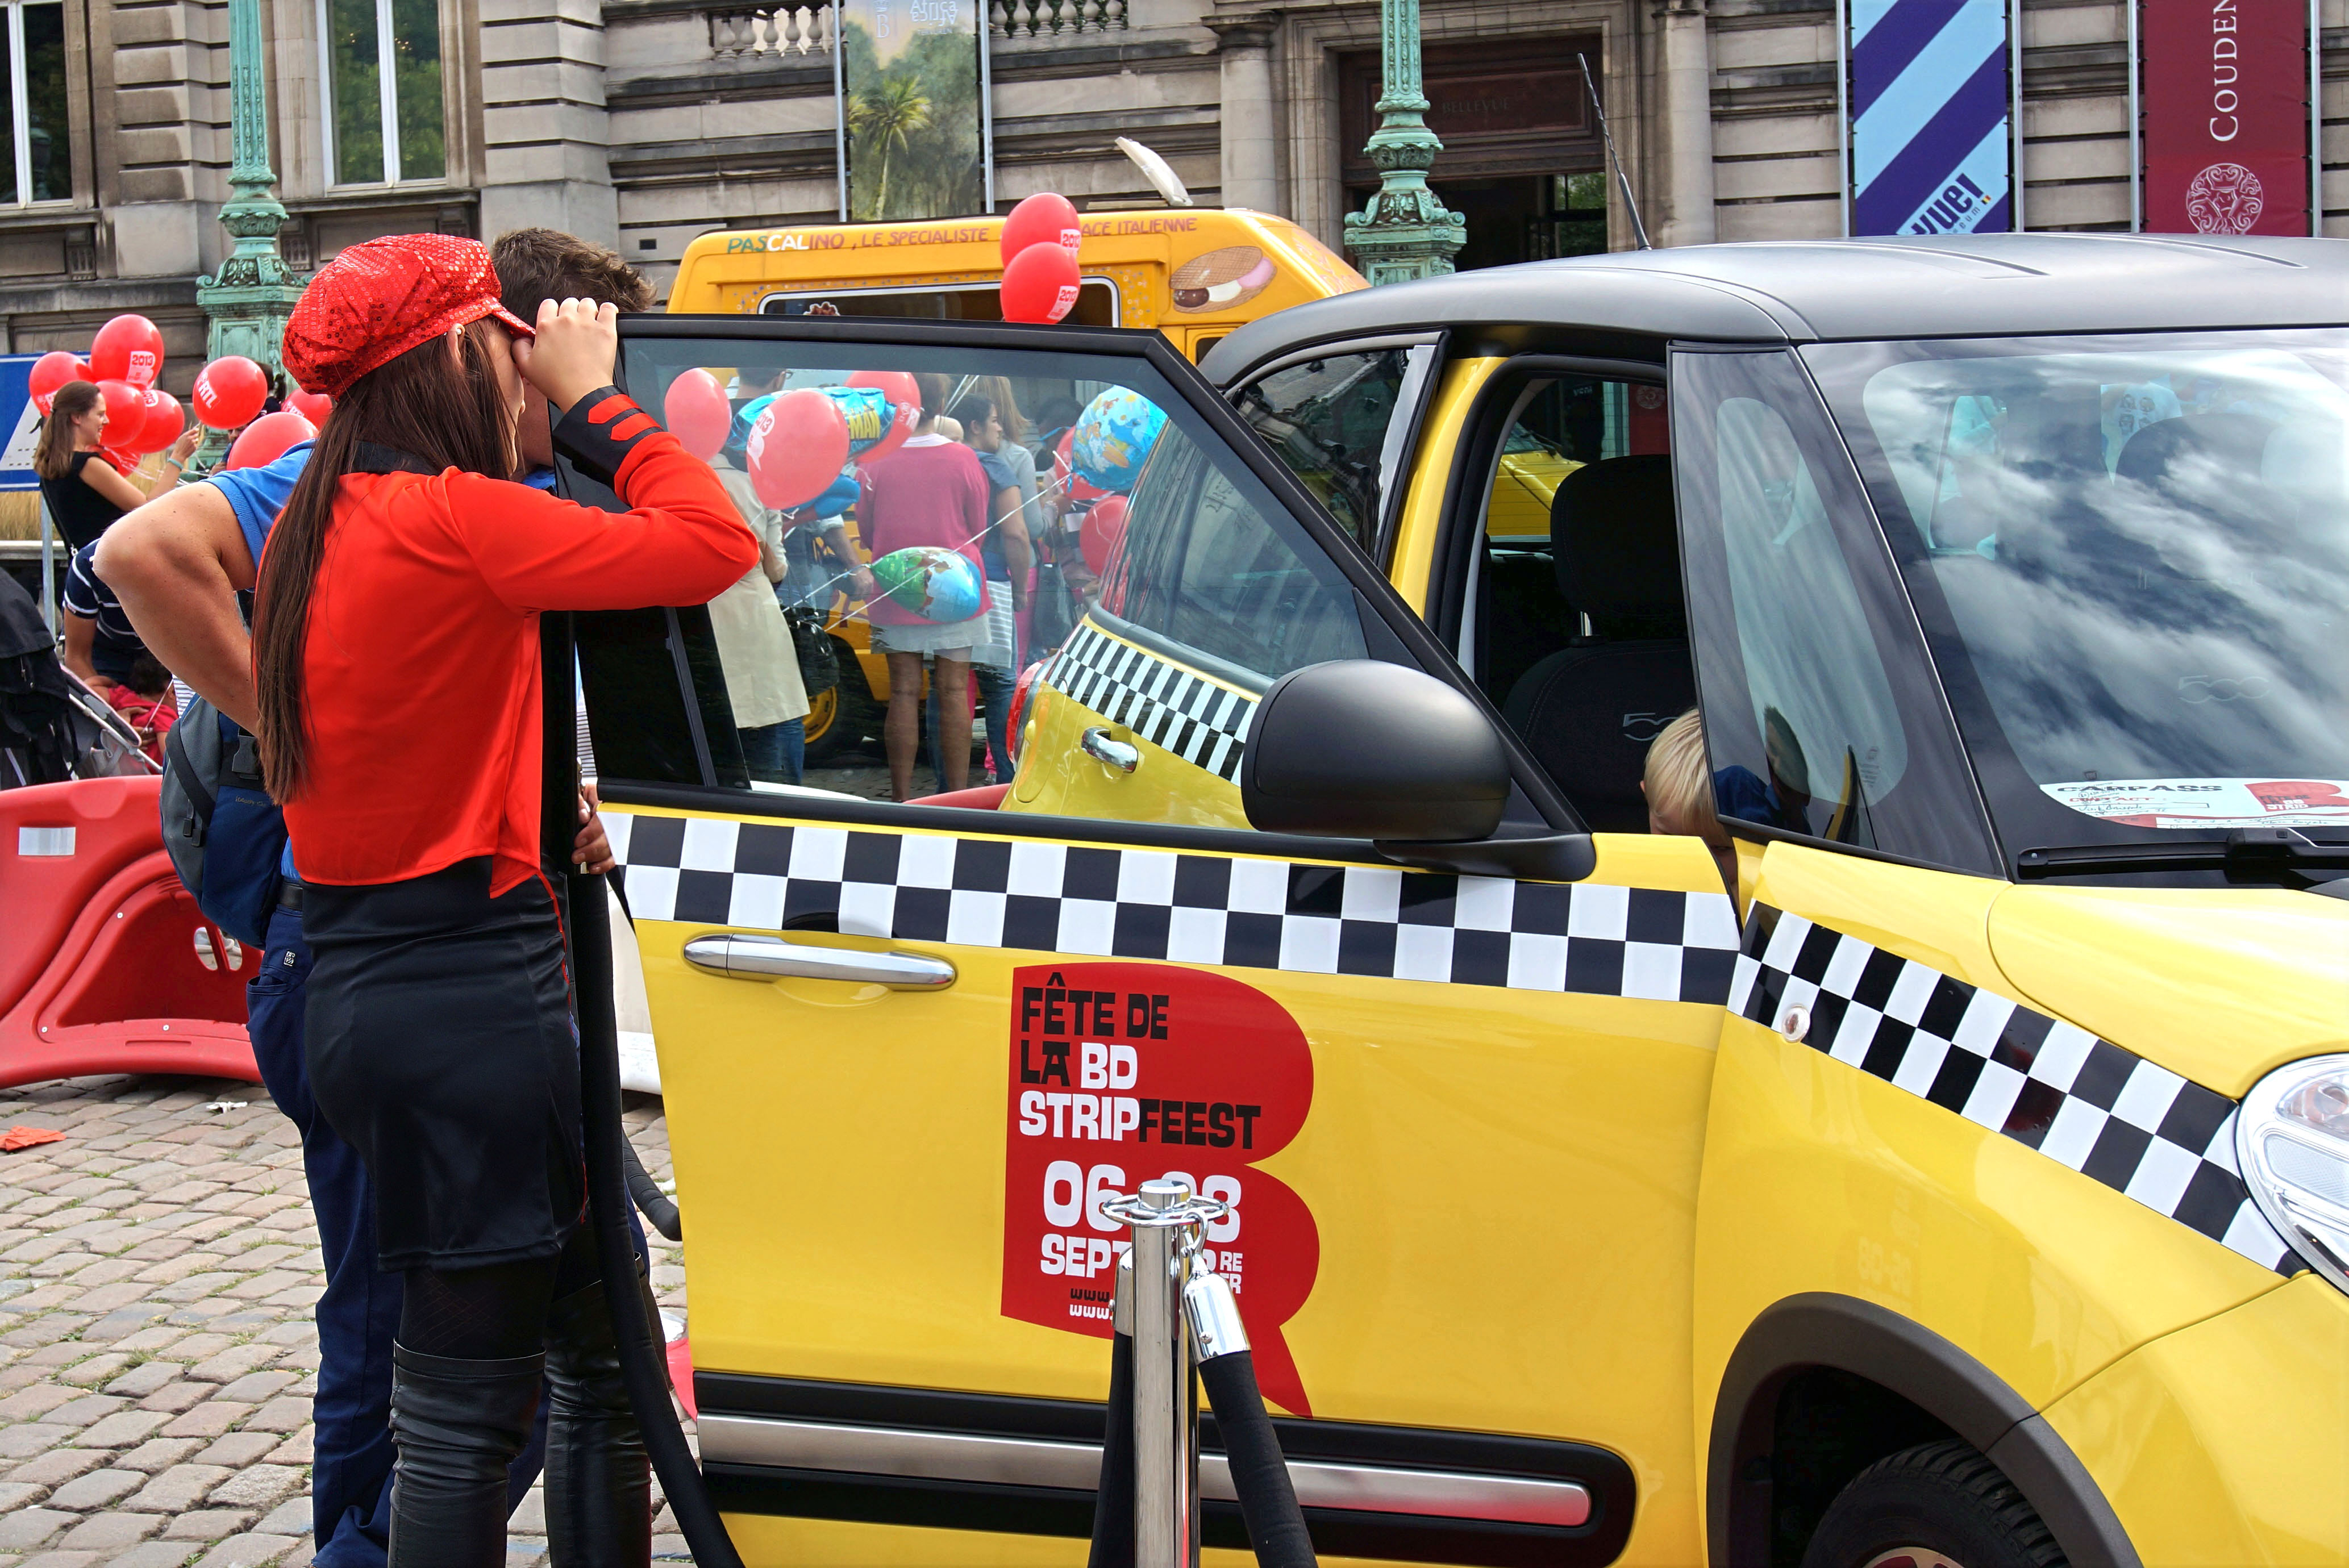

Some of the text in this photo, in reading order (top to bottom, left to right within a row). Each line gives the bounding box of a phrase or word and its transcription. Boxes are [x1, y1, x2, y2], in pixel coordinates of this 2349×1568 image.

[727, 233, 844, 253] PASCALINO
[861, 232, 884, 248] LE
[888, 228, 989, 246] SPECIALISTE
[1081, 221, 1111, 236] ACE
[1118, 217, 1197, 233] ITALIENNE
[132, 355, 153, 366] 2013
[847, 410, 880, 440] MAN
[1022, 972, 1169, 1040] FÊTE DE
[1021, 1040, 1138, 1090] LA BD
